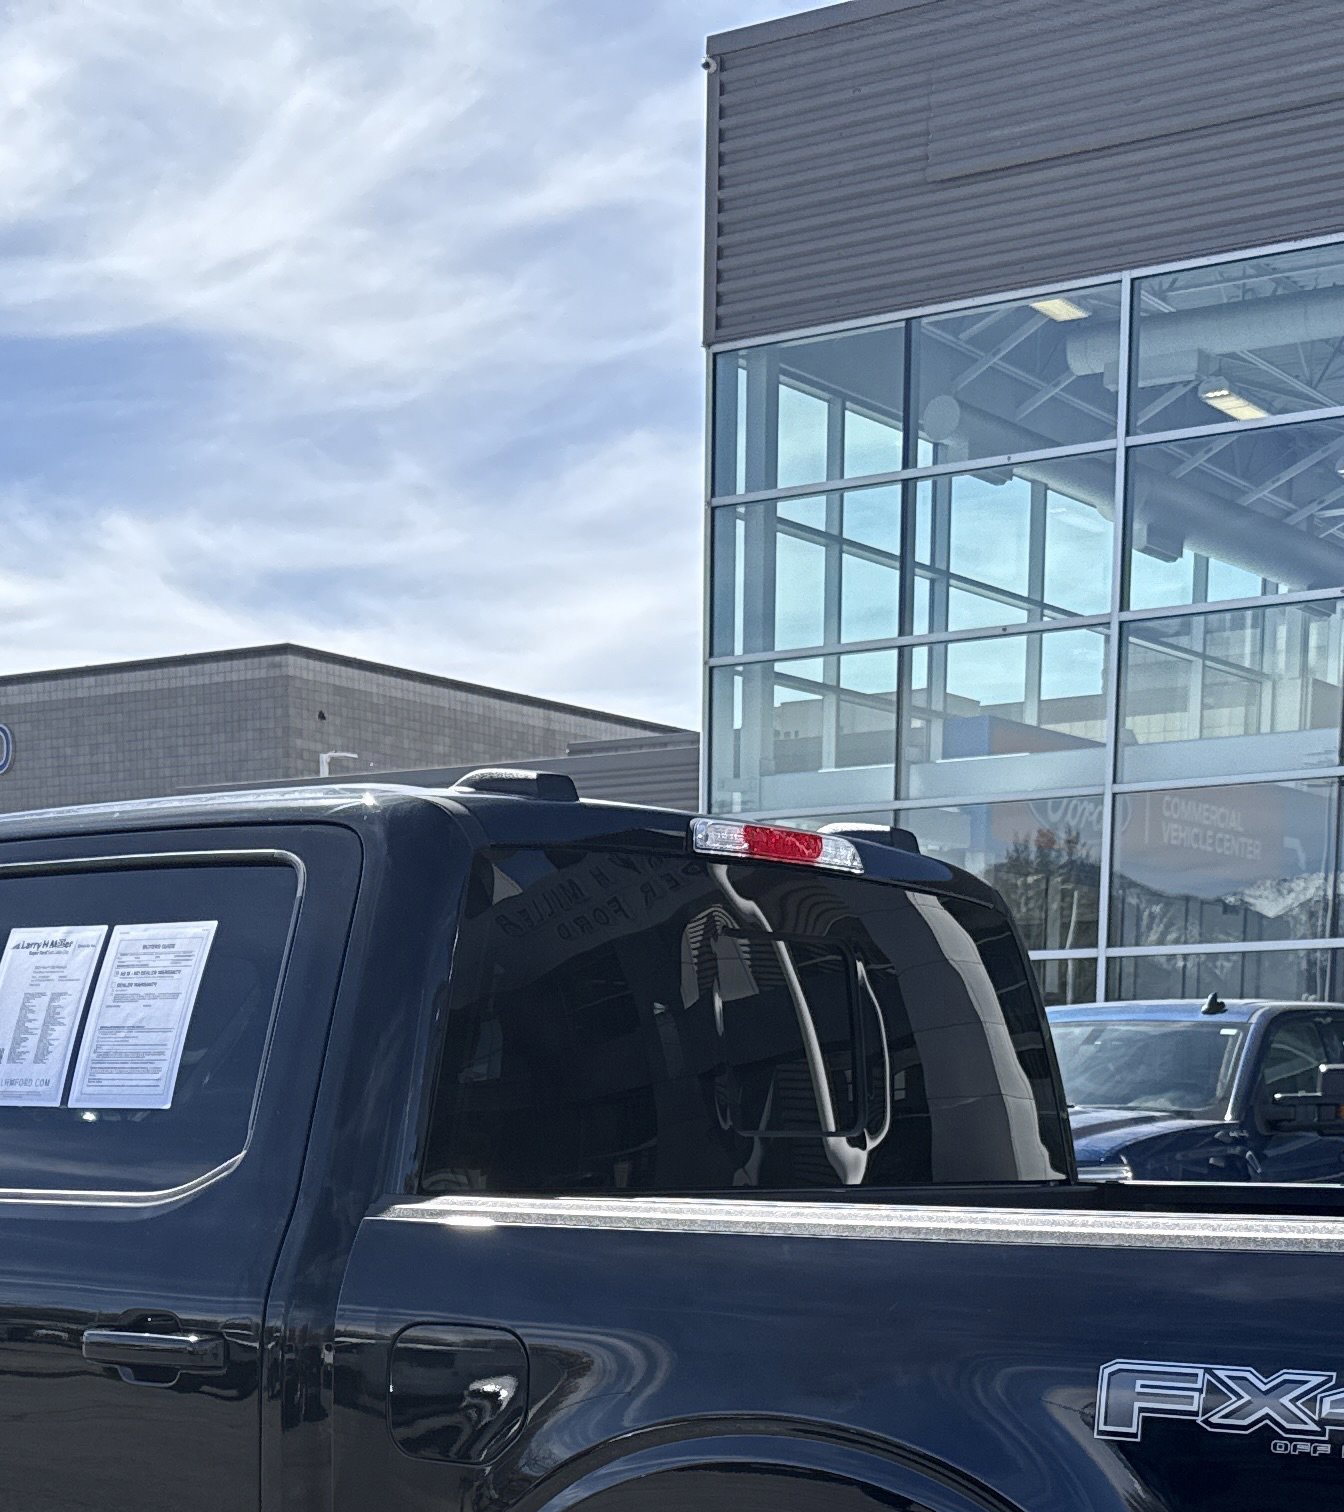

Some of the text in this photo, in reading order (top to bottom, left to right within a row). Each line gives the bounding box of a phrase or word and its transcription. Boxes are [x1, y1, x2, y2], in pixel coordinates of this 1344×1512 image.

[1163, 794, 1245, 832] COMMERCIAL
[1162, 824, 1263, 861] VEHICLE CENTER
[1270, 1439, 1332, 1457] OFF
